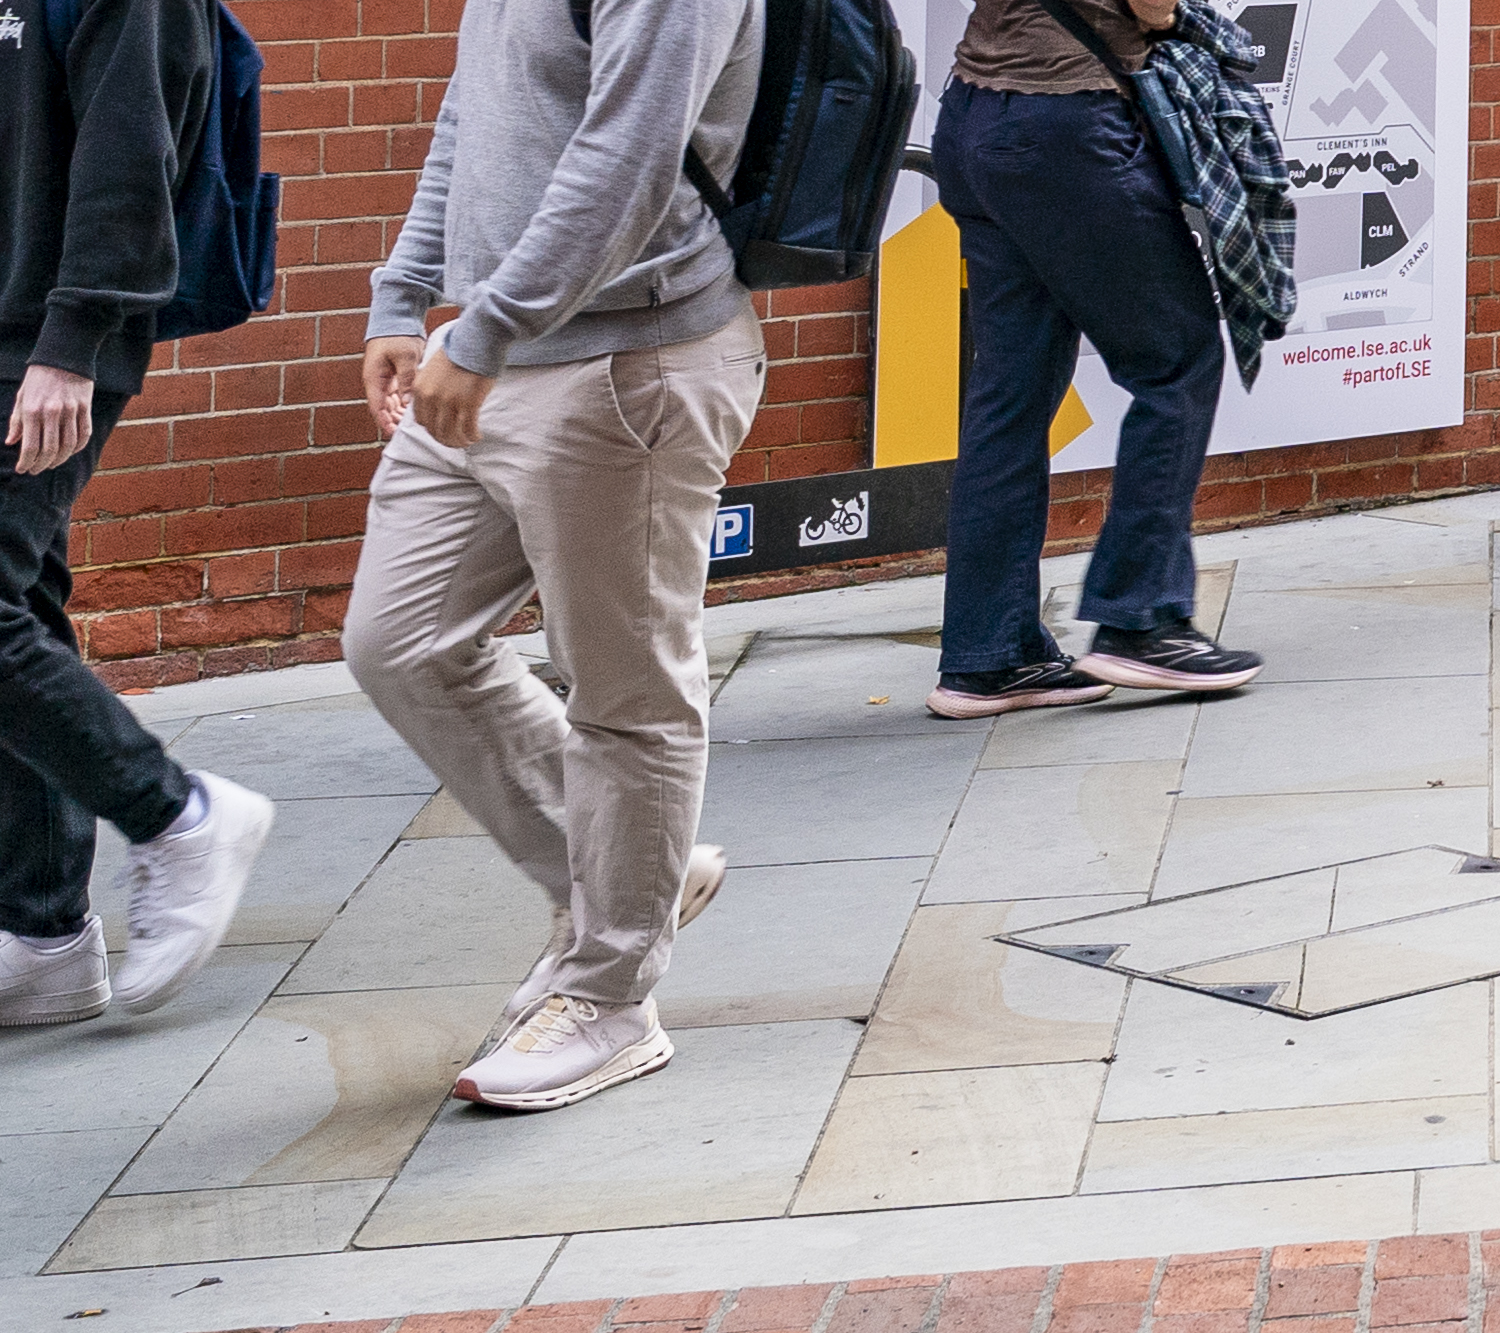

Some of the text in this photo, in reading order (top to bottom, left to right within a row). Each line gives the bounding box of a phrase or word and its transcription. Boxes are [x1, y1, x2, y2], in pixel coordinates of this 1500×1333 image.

[1251, 45, 1266, 58] RB
[1282, 40, 1301, 106] GRANGE COURT
[1316, 136, 1388, 152] CLEMENT'S INN
[1288, 170, 1306, 181] PAN
[1328, 165, 1346, 177] FAW
[1381, 162, 1397, 174] PEL
[1368, 225, 1393, 238] CLM
[1398, 240, 1429, 277] STRAND
[1342, 287, 1389, 301] ALDWYCH
[1283, 334, 1432, 367] welcome.lse.ac.uk
[1342, 359, 1432, 388] #partofLSE
[715, 512, 743, 554] P
